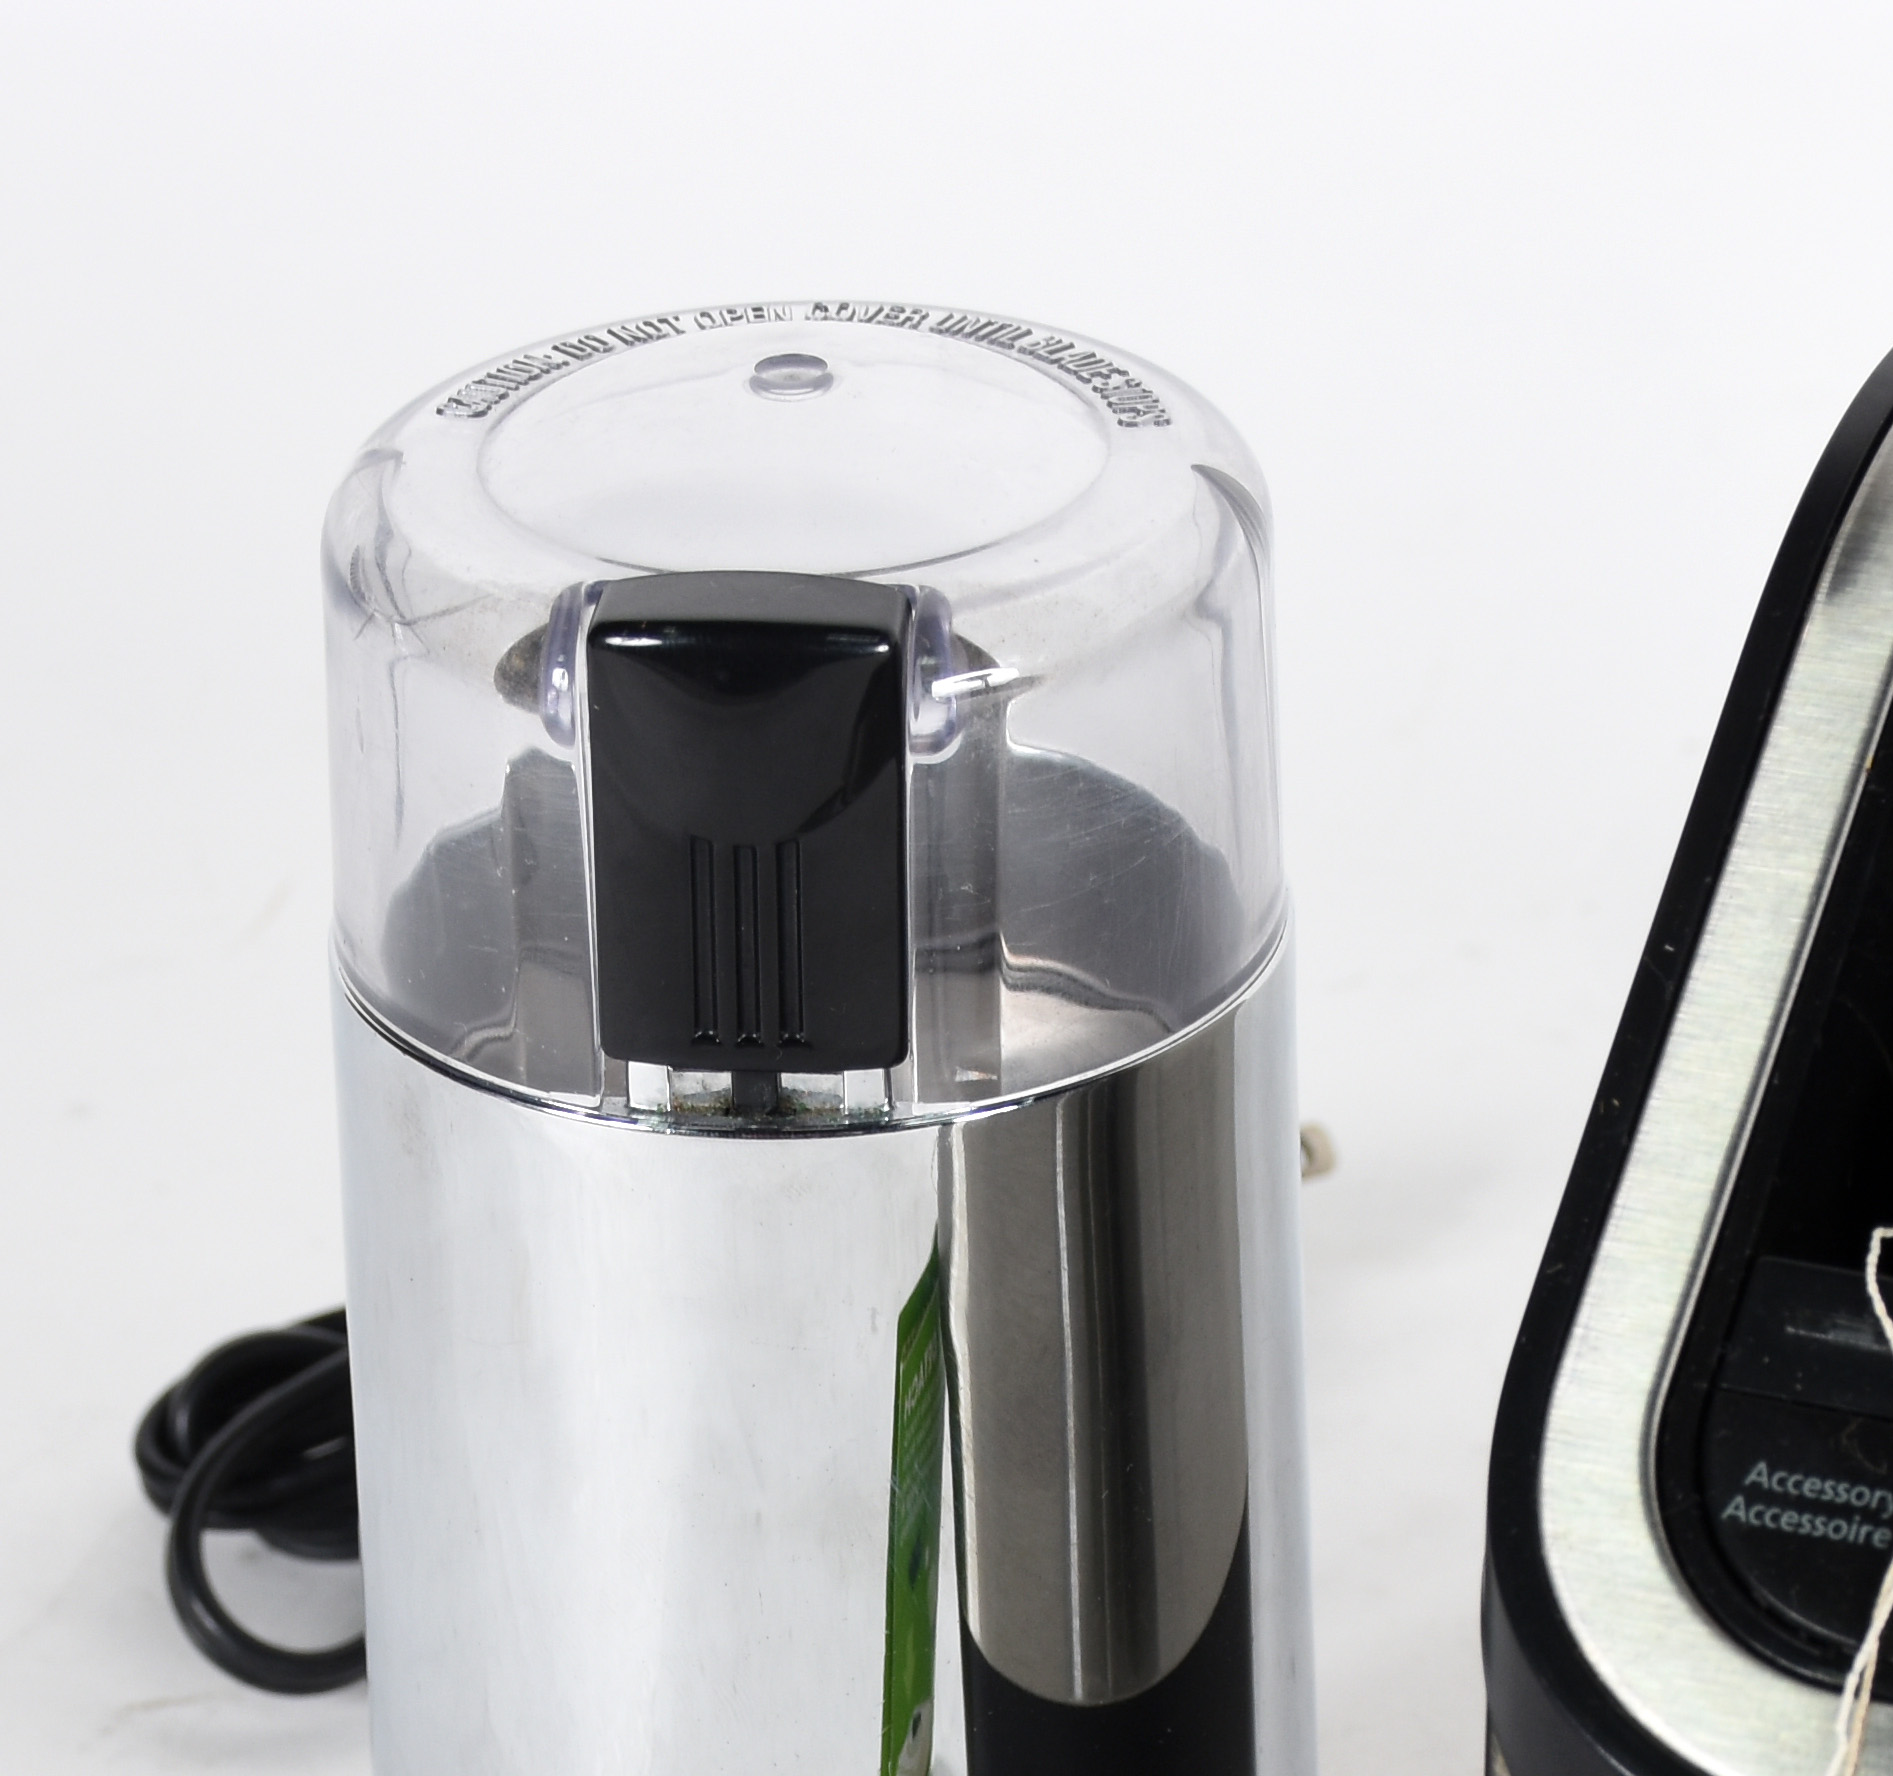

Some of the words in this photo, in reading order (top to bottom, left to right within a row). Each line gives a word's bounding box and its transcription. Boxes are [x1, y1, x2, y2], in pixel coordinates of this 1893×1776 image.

[550, 333, 616, 362] DO
[606, 314, 687, 347] NOT
[693, 304, 794, 331] OPEN
[804, 301, 931, 331] COVER
[928, 313, 1034, 350] UNTIL
[1016, 335, 1130, 385] BLADE
[1721, 1495, 1892, 1549] Accessoire
